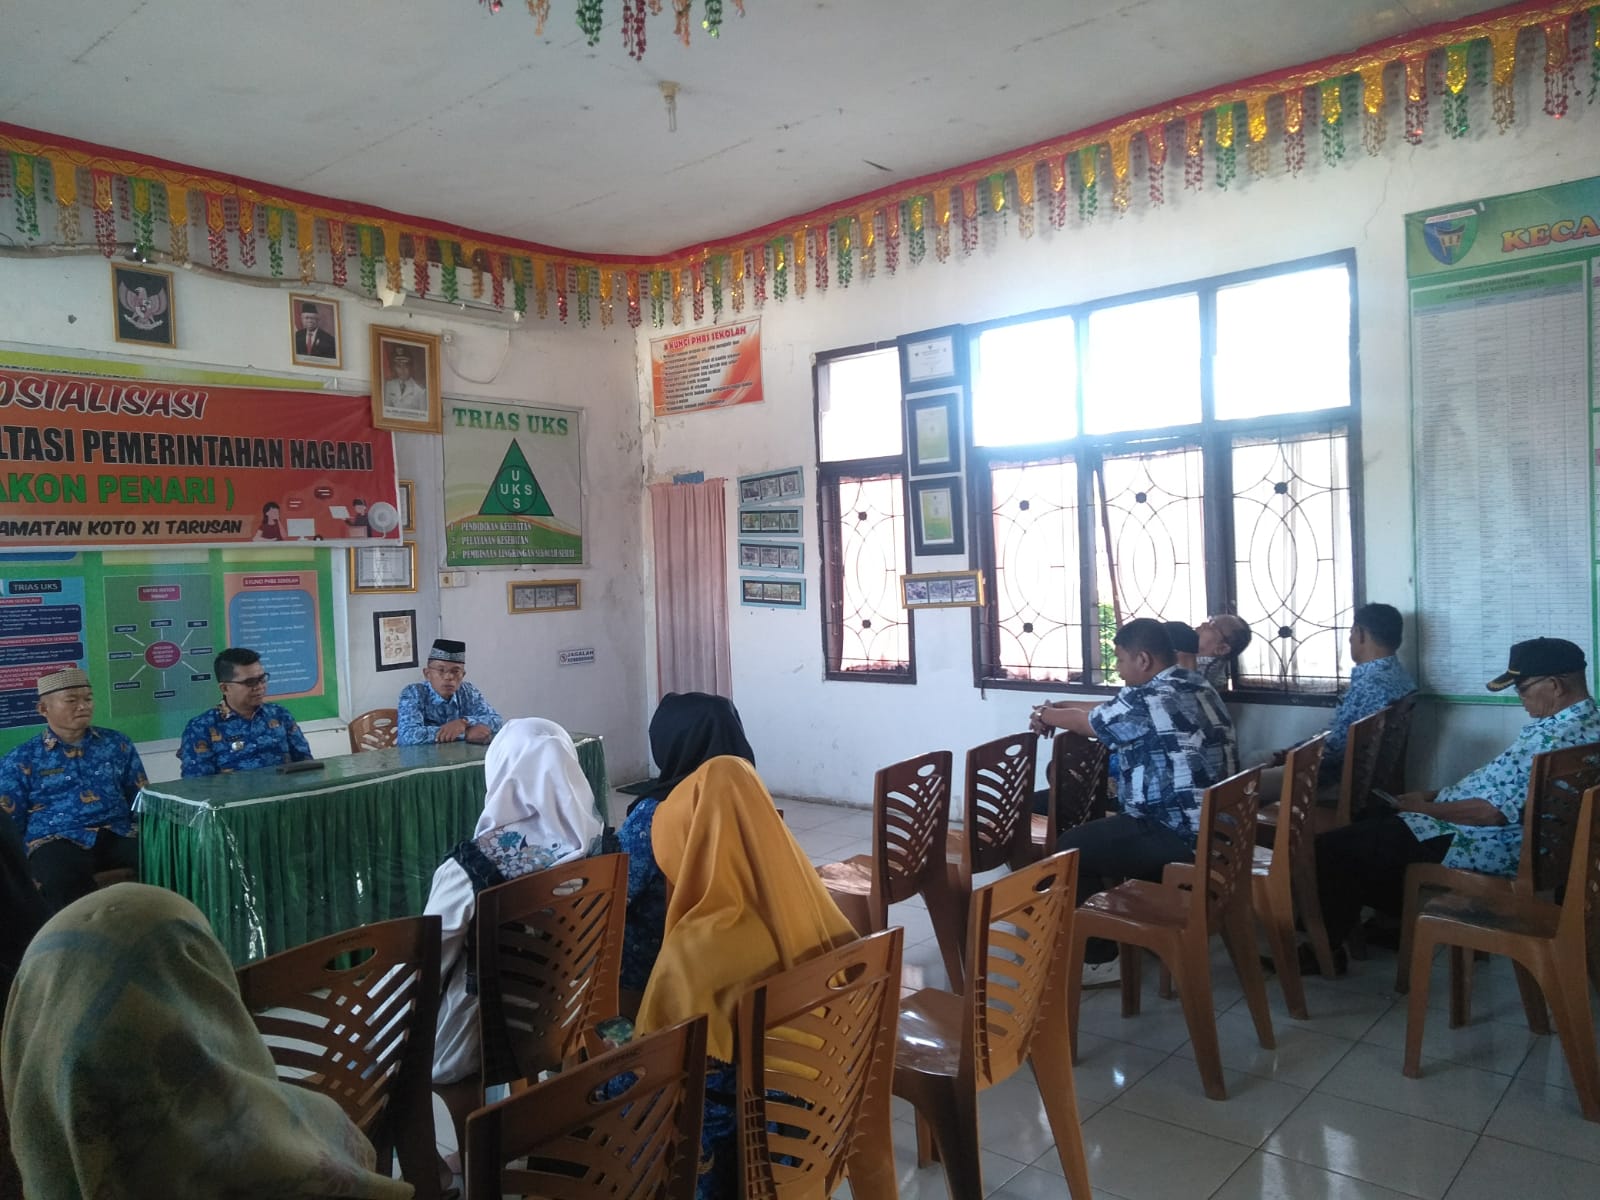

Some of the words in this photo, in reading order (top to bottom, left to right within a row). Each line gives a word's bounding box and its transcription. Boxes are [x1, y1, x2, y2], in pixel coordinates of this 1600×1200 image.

[452, 407, 520, 432] TRIAS
[526, 414, 569, 436] UKS
[81, 428, 284, 470] PEMERINTAHAN
[290, 438, 373, 472] NAGARI
[97, 474, 217, 506] PENARI
[87, 520, 136, 537] KOTO
[142, 520, 161, 536] XI
[166, 519, 243, 535] TARUSAN
[13, 583, 39, 592] TRIAS
[41, 583, 58, 591] UKS
